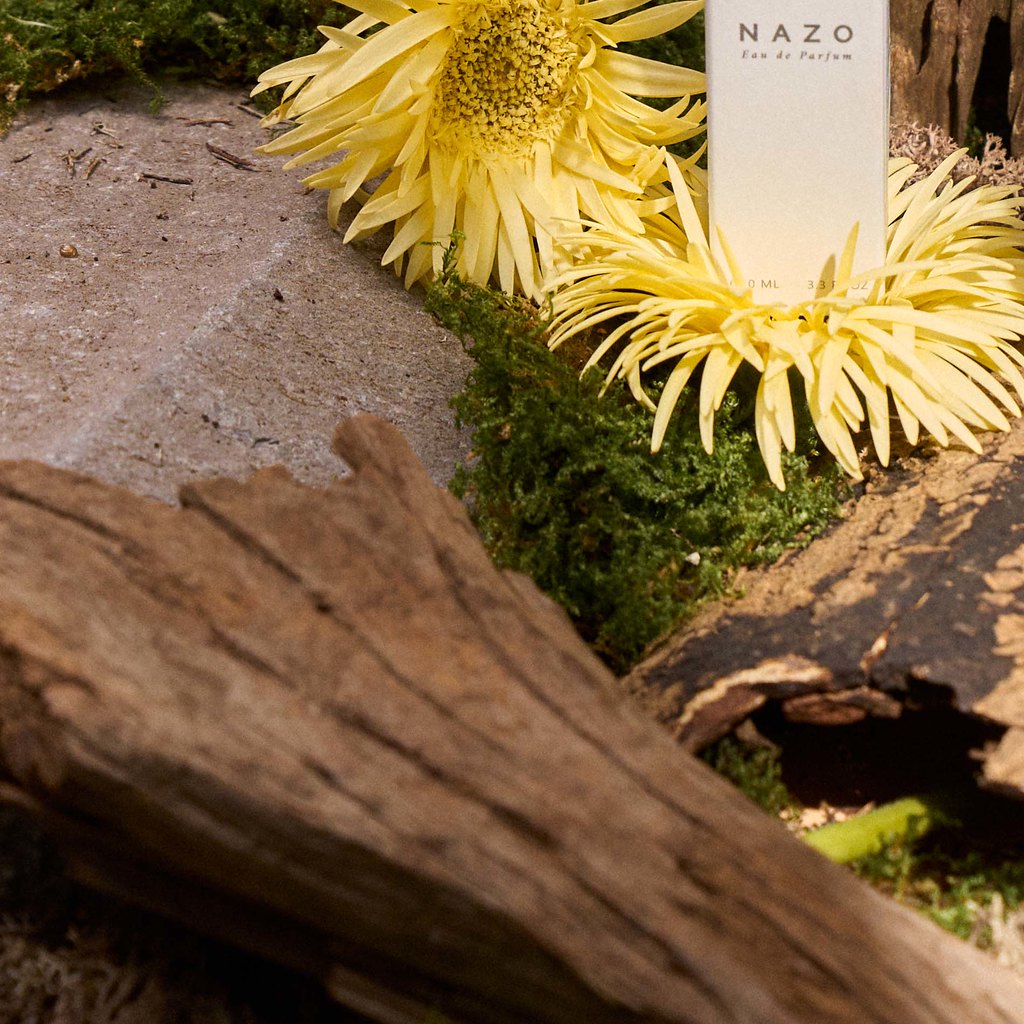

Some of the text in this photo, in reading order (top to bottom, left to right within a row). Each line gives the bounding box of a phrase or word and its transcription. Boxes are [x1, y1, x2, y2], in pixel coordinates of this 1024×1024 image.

[739, 22, 854, 44] NAZO
[742, 49, 853, 63] Eau de Parfum
[761, 279, 780, 289] ML
